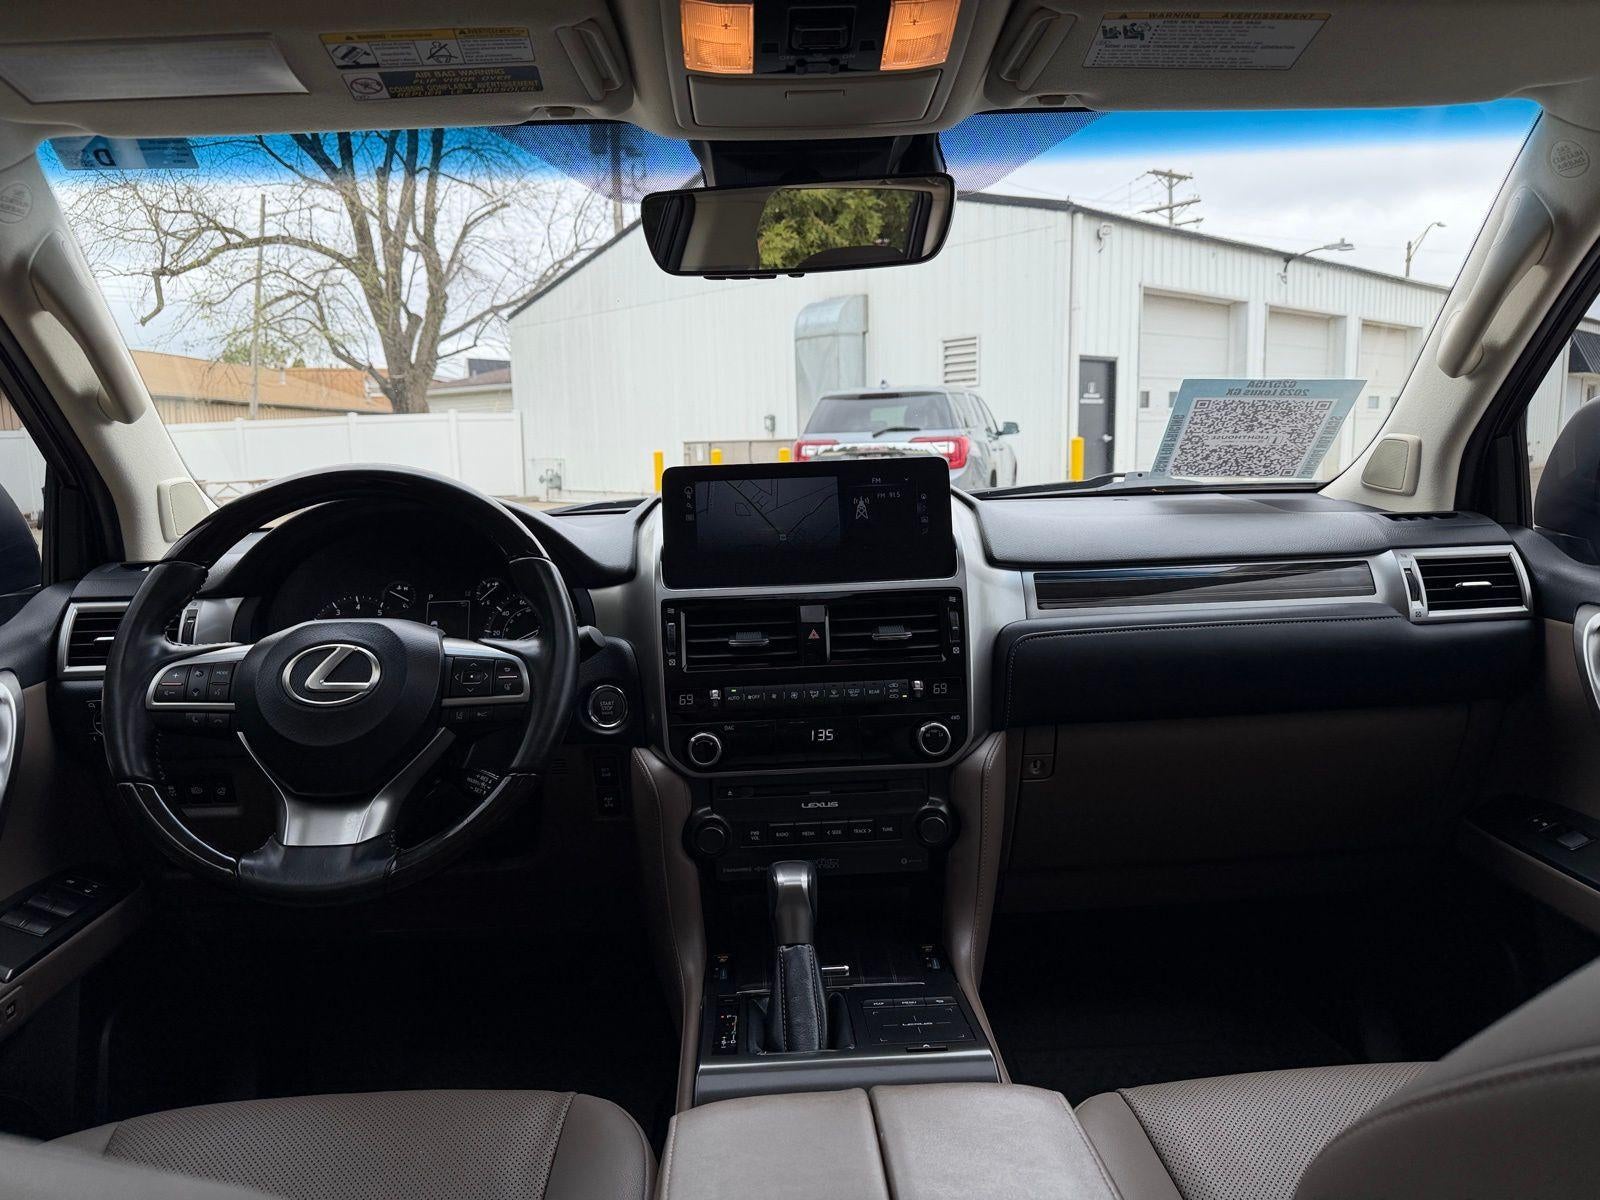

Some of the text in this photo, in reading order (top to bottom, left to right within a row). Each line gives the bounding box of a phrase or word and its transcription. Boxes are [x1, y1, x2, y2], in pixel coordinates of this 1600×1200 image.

[1221, 12, 1313, 20] AVERTISSEMENT
[415, 68, 505, 79] AIR BAG WARNING
[932, 682, 948, 694] 69
[680, 694, 694, 706] 69
[801, 801, 839, 809] LEXUS
